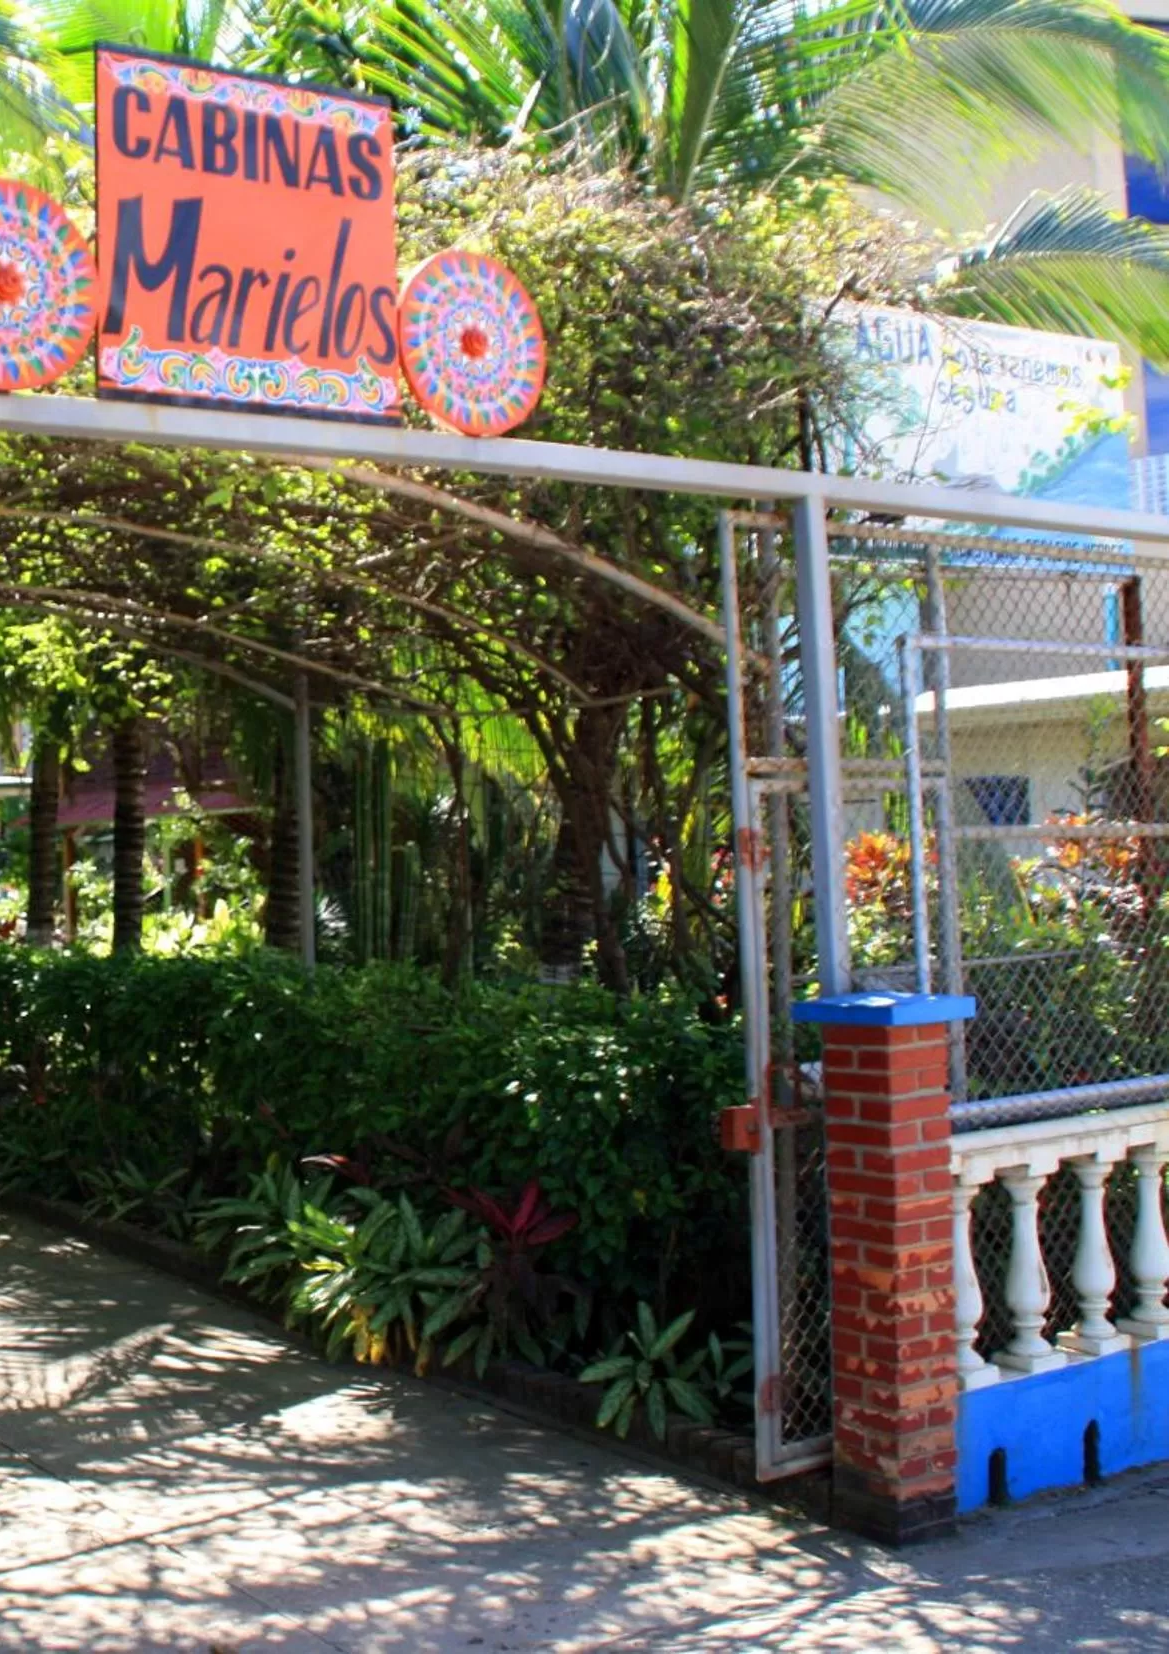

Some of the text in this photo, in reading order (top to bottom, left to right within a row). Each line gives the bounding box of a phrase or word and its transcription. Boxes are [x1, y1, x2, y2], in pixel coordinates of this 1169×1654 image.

[111, 85, 383, 201] CABINAS
[102, 195, 398, 365] Marielos
[937, 381, 1016, 415] segua
